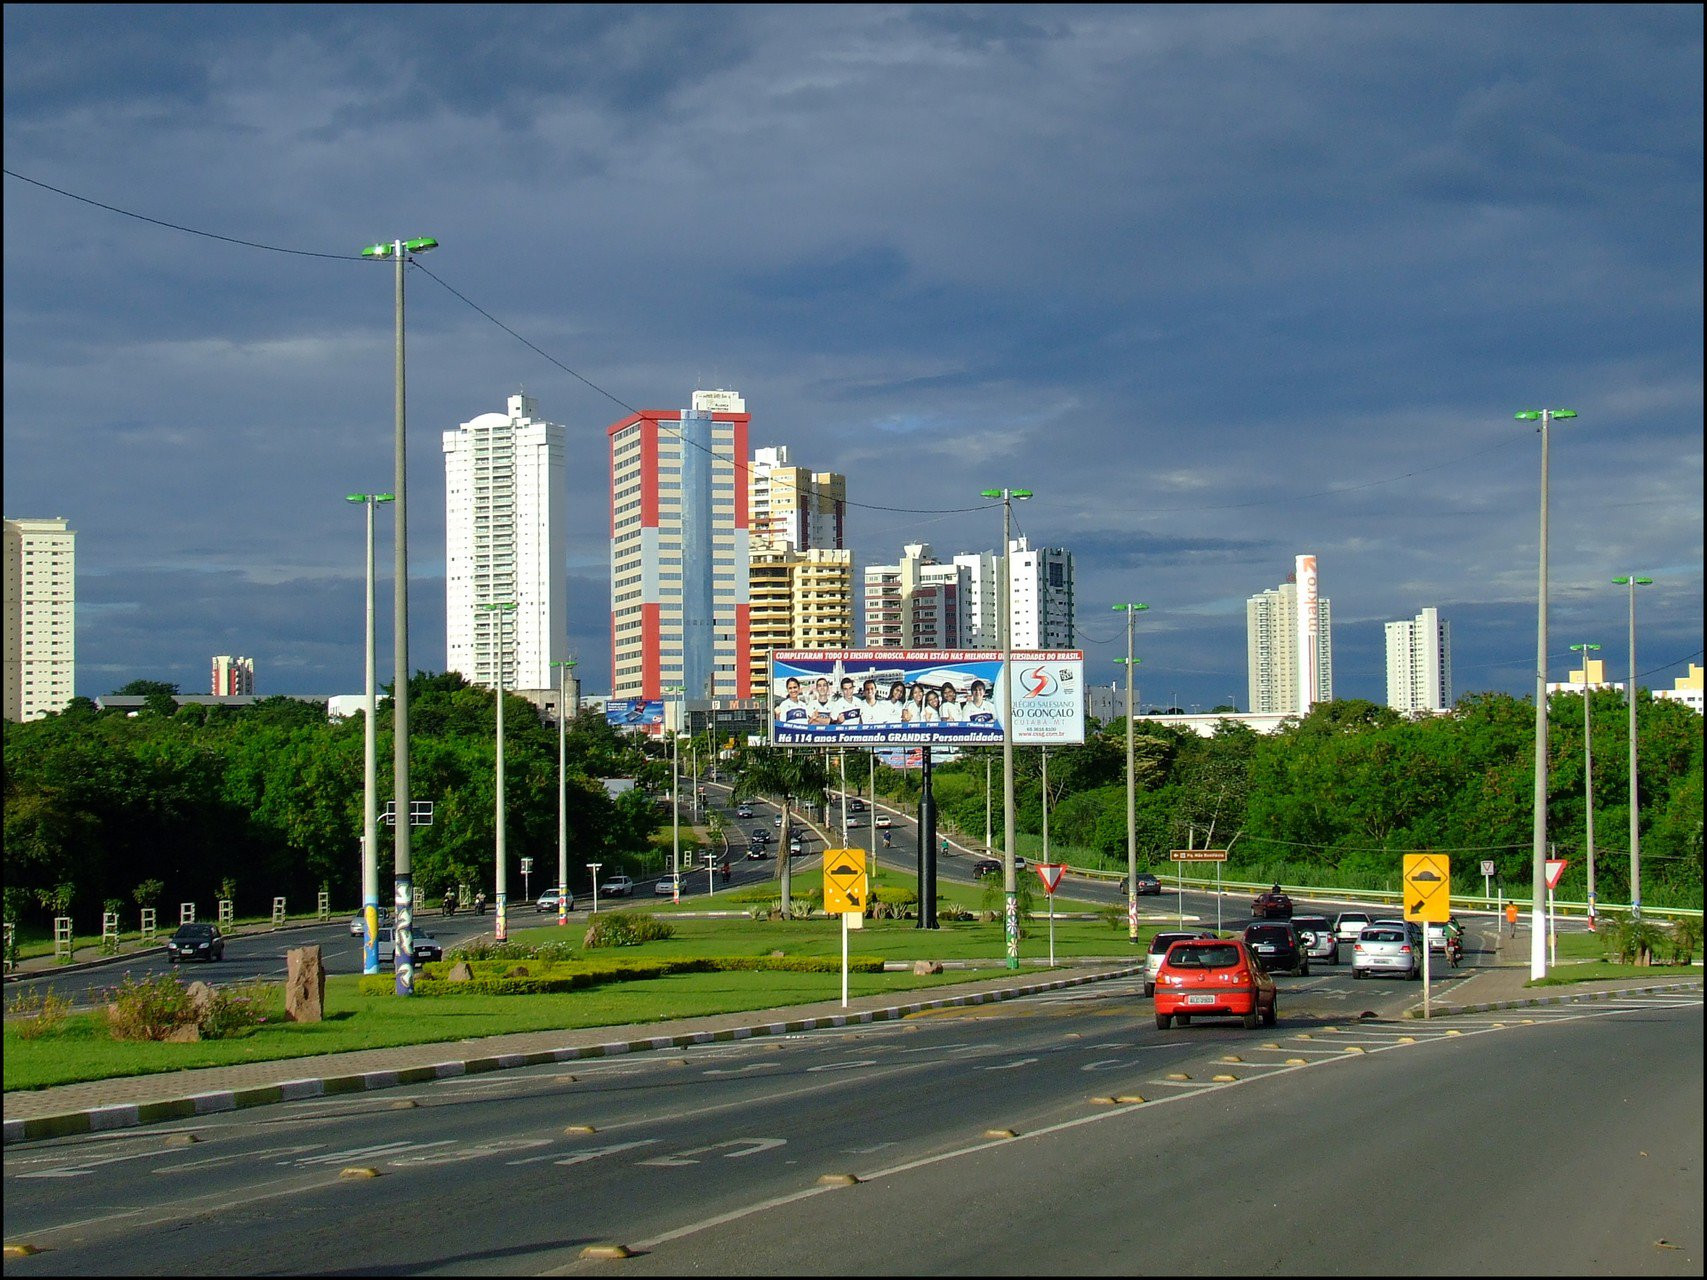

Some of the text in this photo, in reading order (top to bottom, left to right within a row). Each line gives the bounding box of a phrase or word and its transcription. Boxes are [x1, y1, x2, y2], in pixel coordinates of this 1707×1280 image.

[775, 652, 1081, 660] COMPLETARAM TODO O ENSINO CONOSCO. AGORA ESTÃO NAS MELHORES UVERSIDADES DO BRASIL.
[1027, 708, 1075, 719] GONÇALO
[778, 732, 1004, 743] Há 114 anos Formando GRANDES Personalidades
